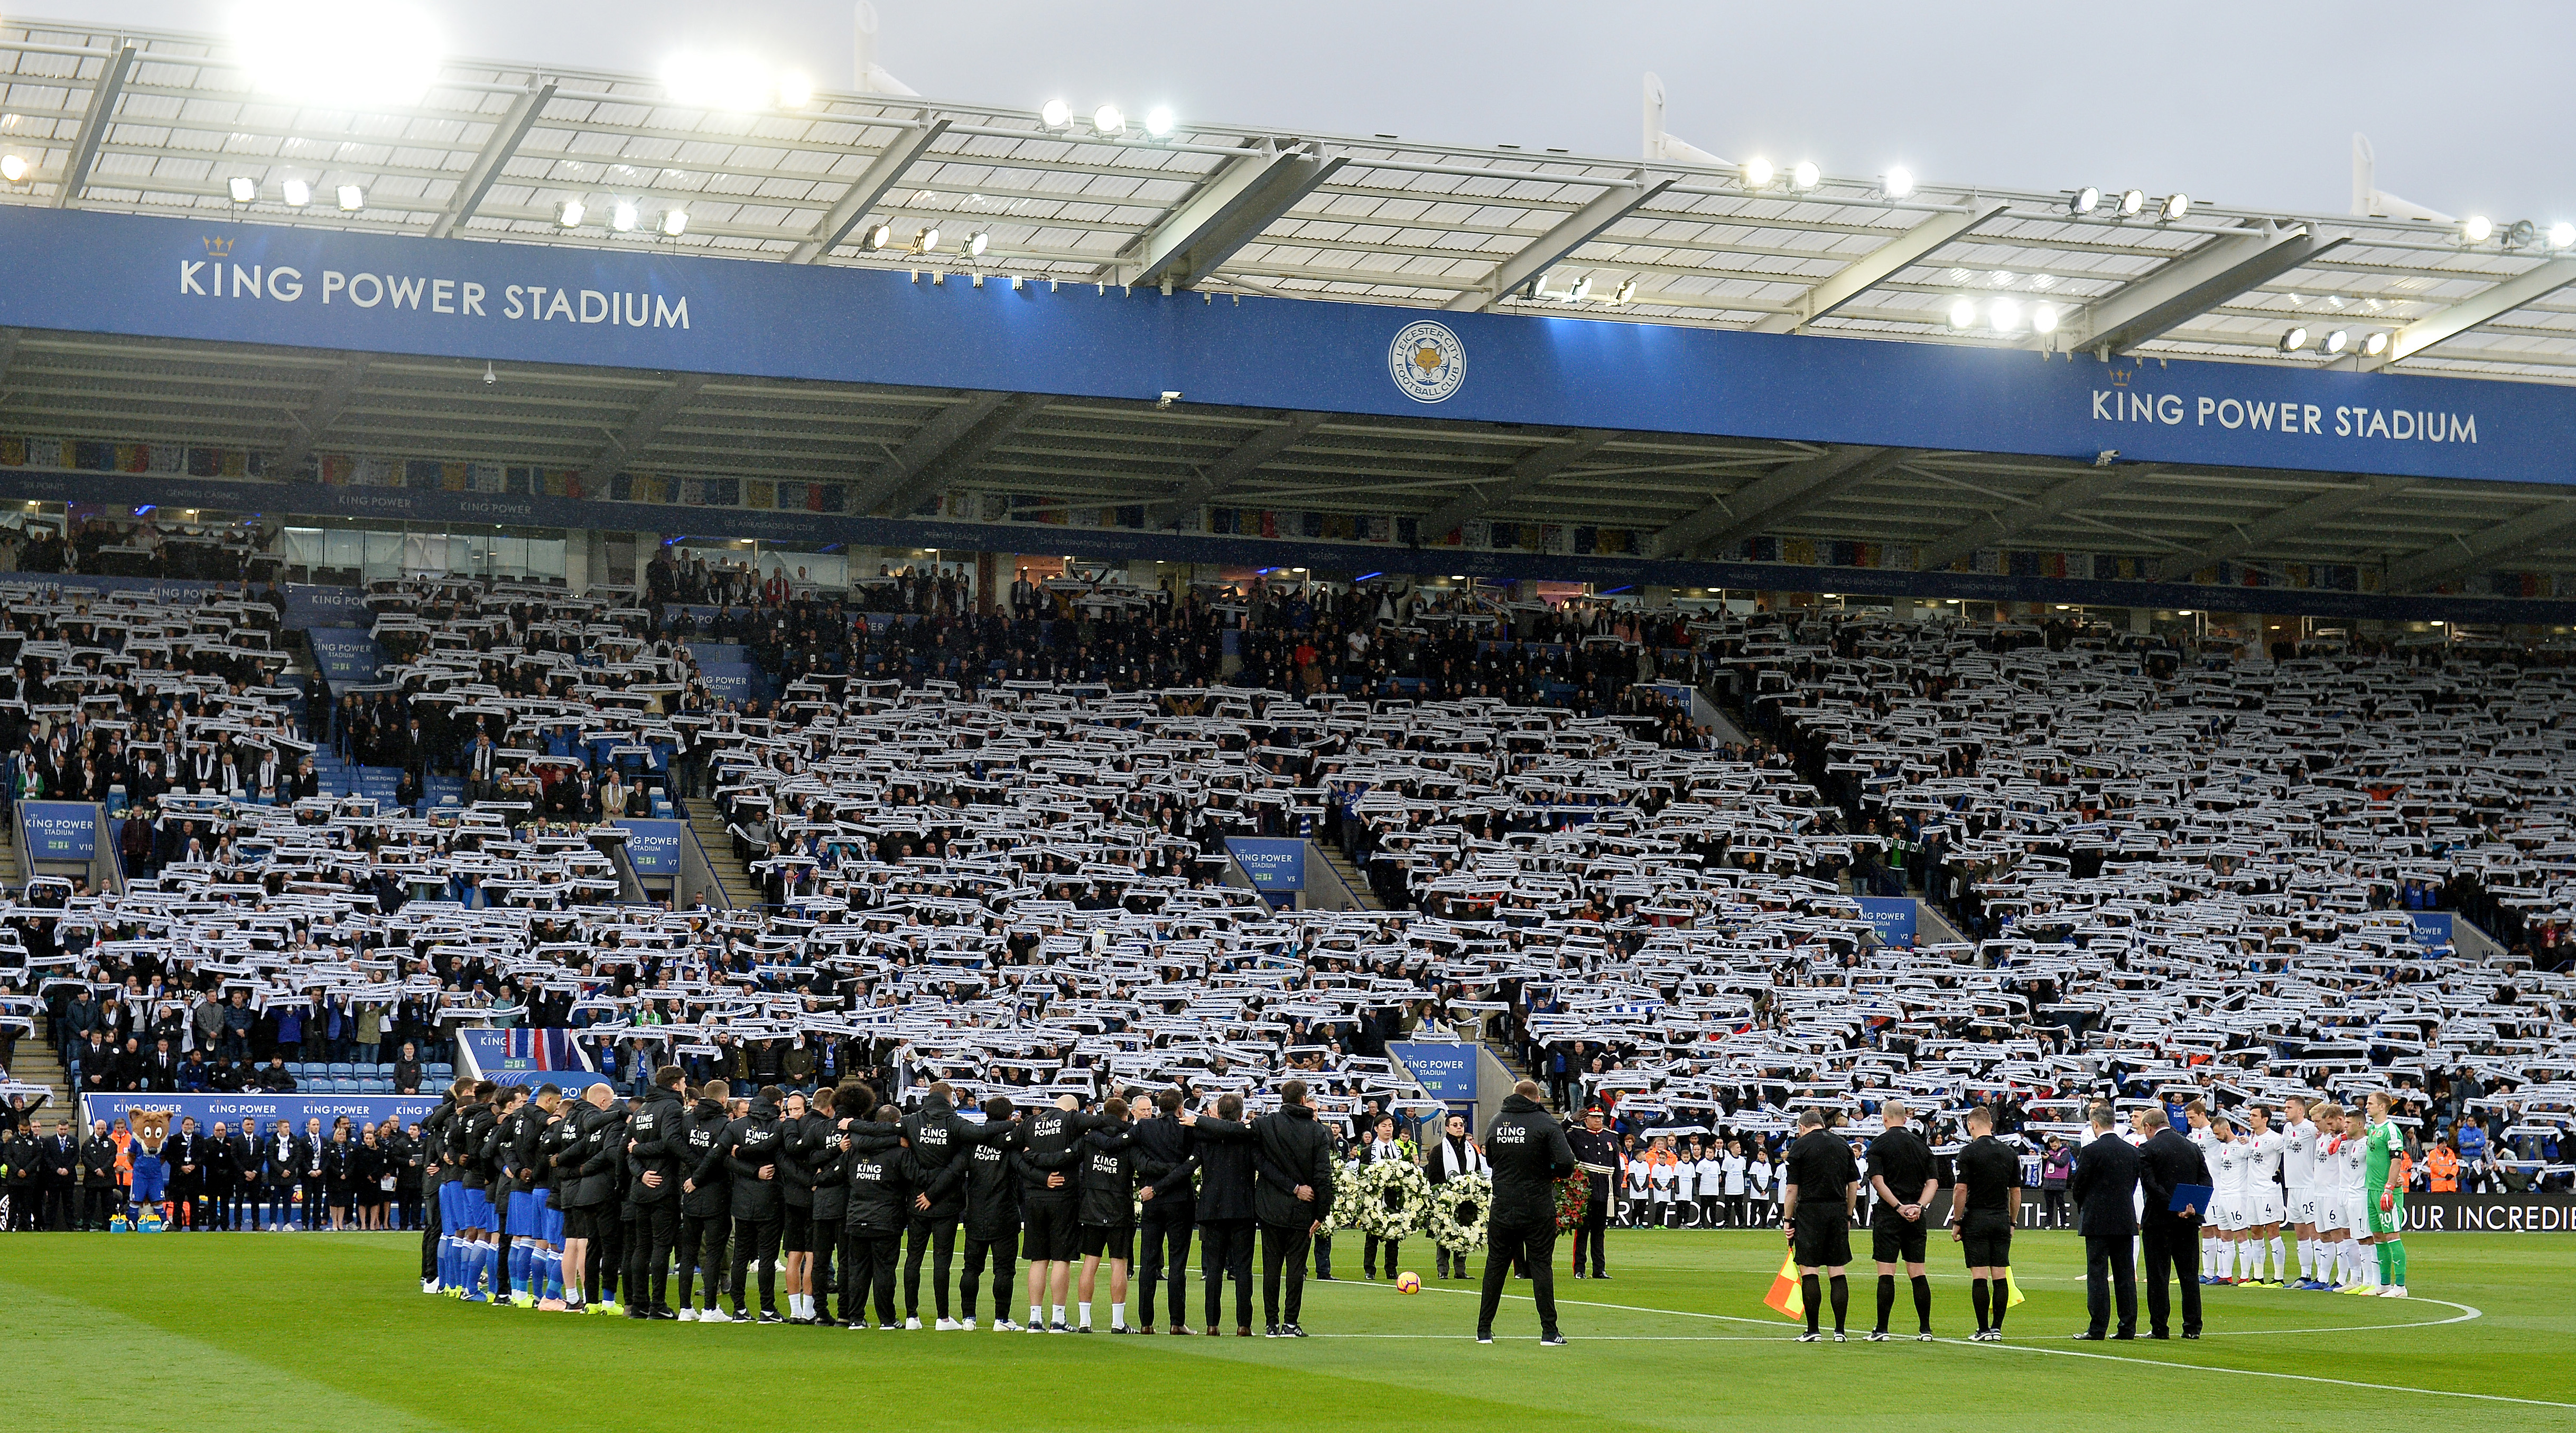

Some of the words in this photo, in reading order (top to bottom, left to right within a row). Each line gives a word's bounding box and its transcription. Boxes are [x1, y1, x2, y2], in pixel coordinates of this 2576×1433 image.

[180, 259, 303, 302] KING
[321, 270, 486, 317] POWER
[504, 284, 691, 330] STADIUM
[1396, 327, 1444, 357] LEICESTER
[1445, 338, 1461, 361] CITY
[1396, 363, 1441, 396] FOOTBALL
[1441, 366, 1459, 391] CLUB
[2092, 389, 2184, 426] KING
[2198, 396, 2323, 435] POWER
[2335, 405, 2478, 444] STADIUM
[339, 495, 367, 506] KING
[371, 497, 411, 508] POWER
[460, 502, 488, 513] KING
[492, 504, 531, 515] POWER
[150, 588, 180, 598] KING
[312, 595, 341, 606] KING
[339, 644, 371, 653] POWER
[715, 676, 746, 685] POWER
[26, 819, 53, 829] KING
[56, 820, 93, 830] POWER
[644, 836, 678, 845] POWER
[79, 843, 94, 851] V10
[1236, 853, 1259, 862] KING
[1876, 912, 1905, 920] POWER
[2414, 927, 2442, 935] POWER
[481, 1036, 507, 1046] KING
[1430, 1060, 1464, 1069] POWER
[145, 1104, 182, 1113] POWER
[209, 1104, 237, 1114] KING
[239, 1105, 276, 1114] POWER
[303, 1105, 331, 1114] KING
[333, 1106, 370, 1115] POWER
[396, 1106, 423, 1115] KING
[636, 1113, 654, 1124] KING
[1035, 1119, 1062, 1130] KING
[746, 1128, 768, 1140] KING
[920, 1127, 947, 1138] KING
[1034, 1127, 1061, 1137] POWER
[1496, 1127, 1526, 1136] KING
[919, 1136, 947, 1145] POWER
[974, 1152, 1000, 1161] POWER
[857, 1163, 882, 1174] KING
[1092, 1164, 1117, 1174] POWER
[2265, 1203, 2272, 1214] 4
[2231, 1211, 2242, 1221] 16
[2329, 1210, 2336, 1220] 6
[2379, 1212, 2392, 1224] 20
